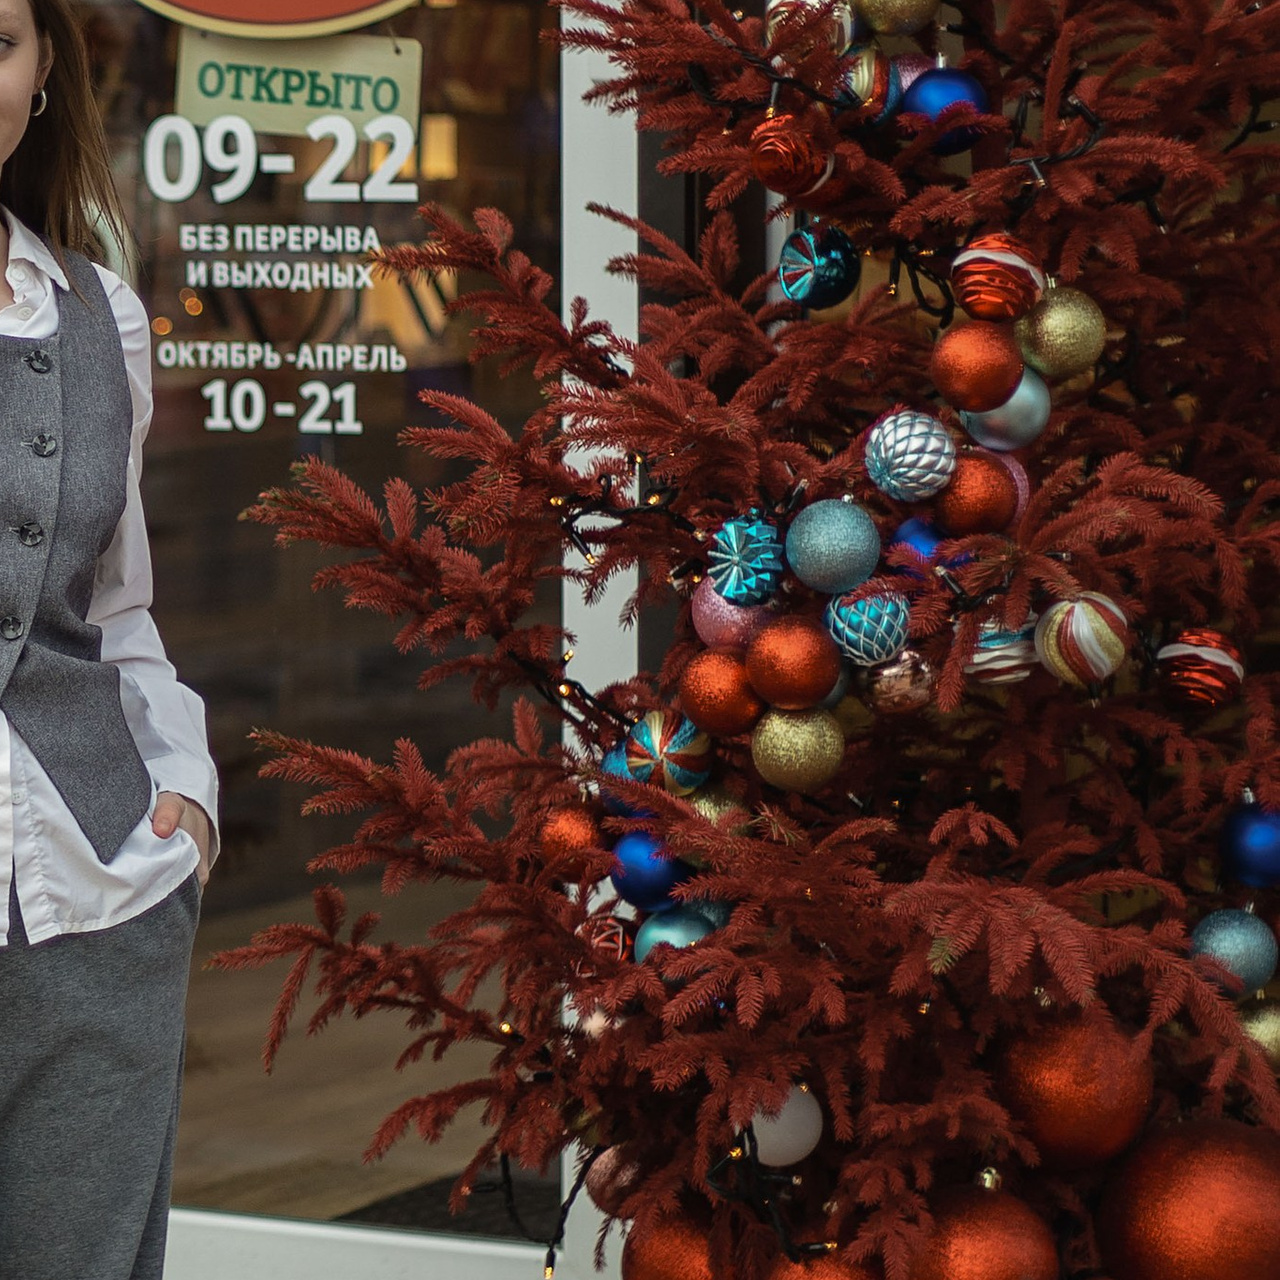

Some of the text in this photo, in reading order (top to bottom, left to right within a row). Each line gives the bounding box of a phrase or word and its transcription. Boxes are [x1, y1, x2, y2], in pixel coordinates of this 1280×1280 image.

[197, 61, 400, 114] ОТКРЫТО
[179, 224, 382, 253] БЕЗ ПЕРЕРЫВА
[186, 260, 374, 292] И ВЫХОДНЫХ
